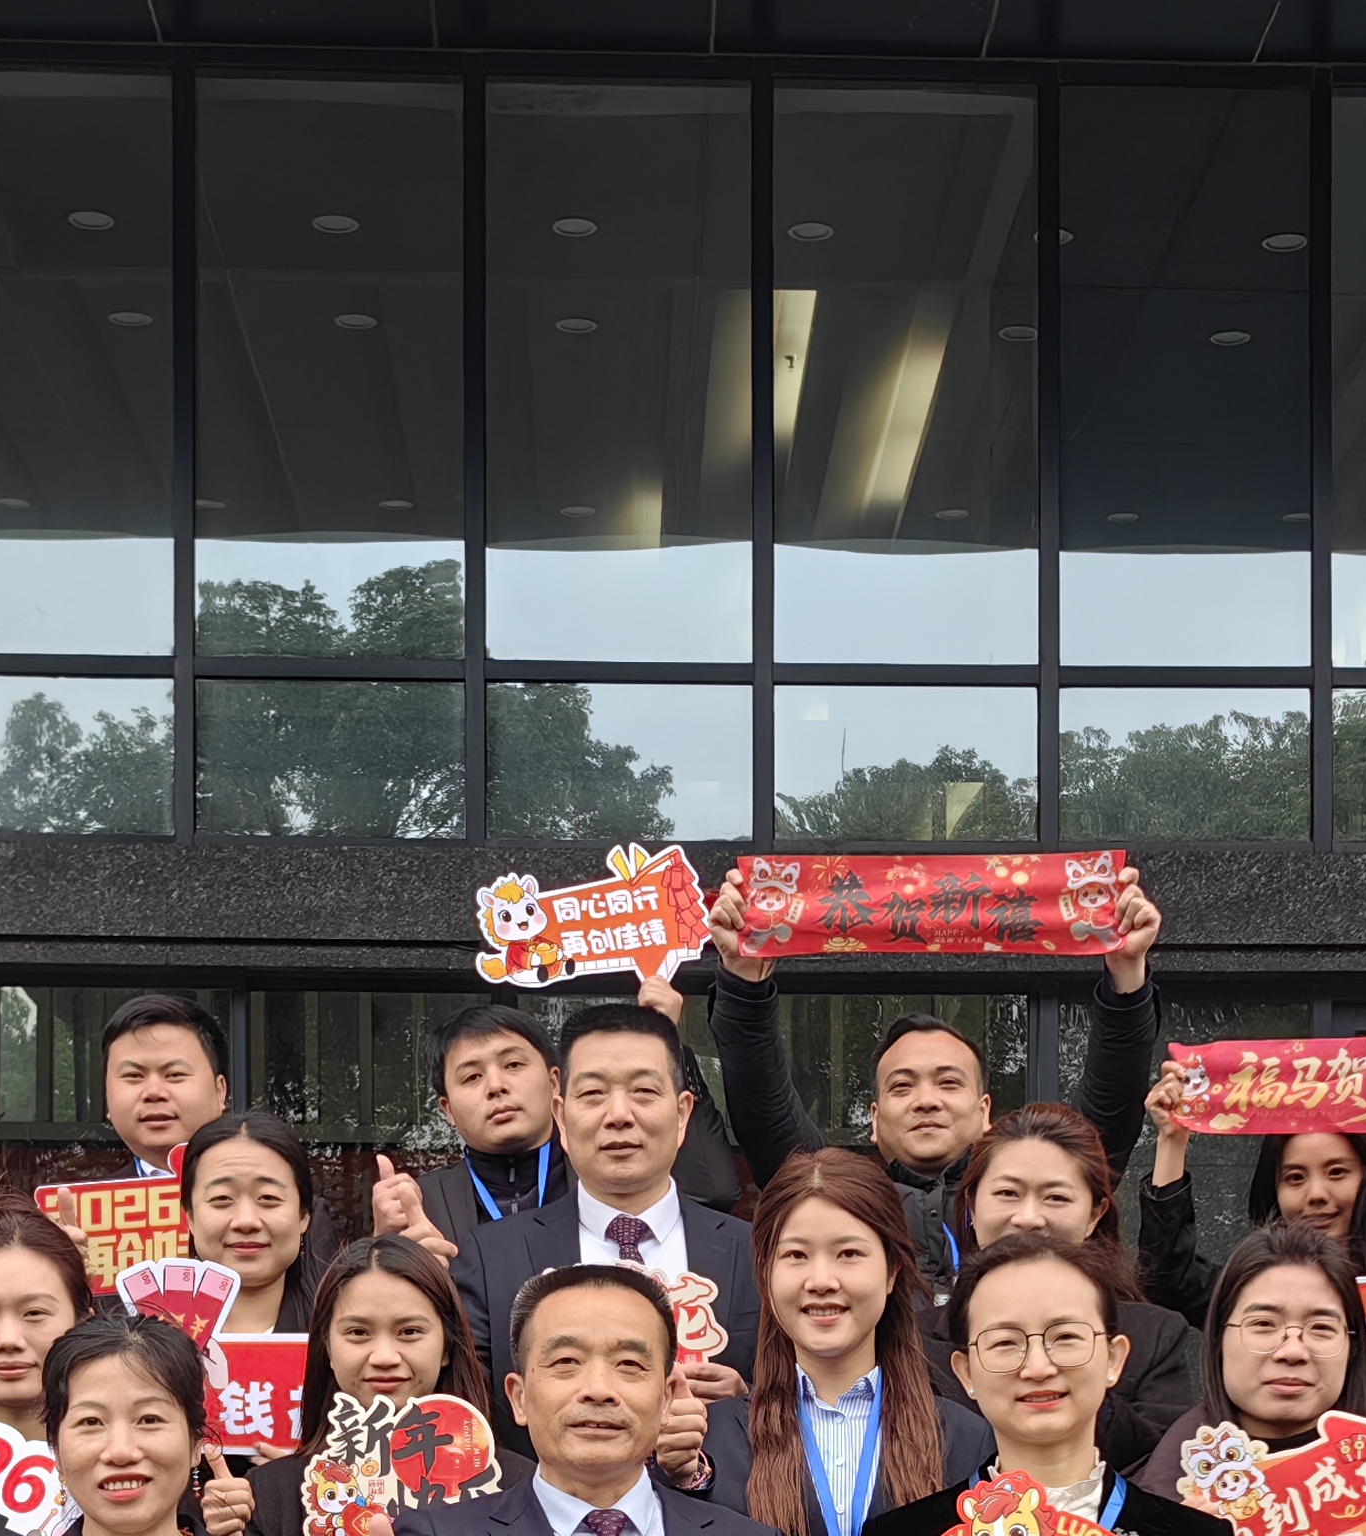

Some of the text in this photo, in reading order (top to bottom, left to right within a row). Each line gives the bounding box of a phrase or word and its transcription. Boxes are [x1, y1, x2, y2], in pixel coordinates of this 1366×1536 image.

[553, 886, 659, 923] 同心同行
[819, 870, 1047, 945] 恭贺新禧
[561, 919, 667, 958] 再创佳绩
[333, 1399, 454, 1477] 新年
